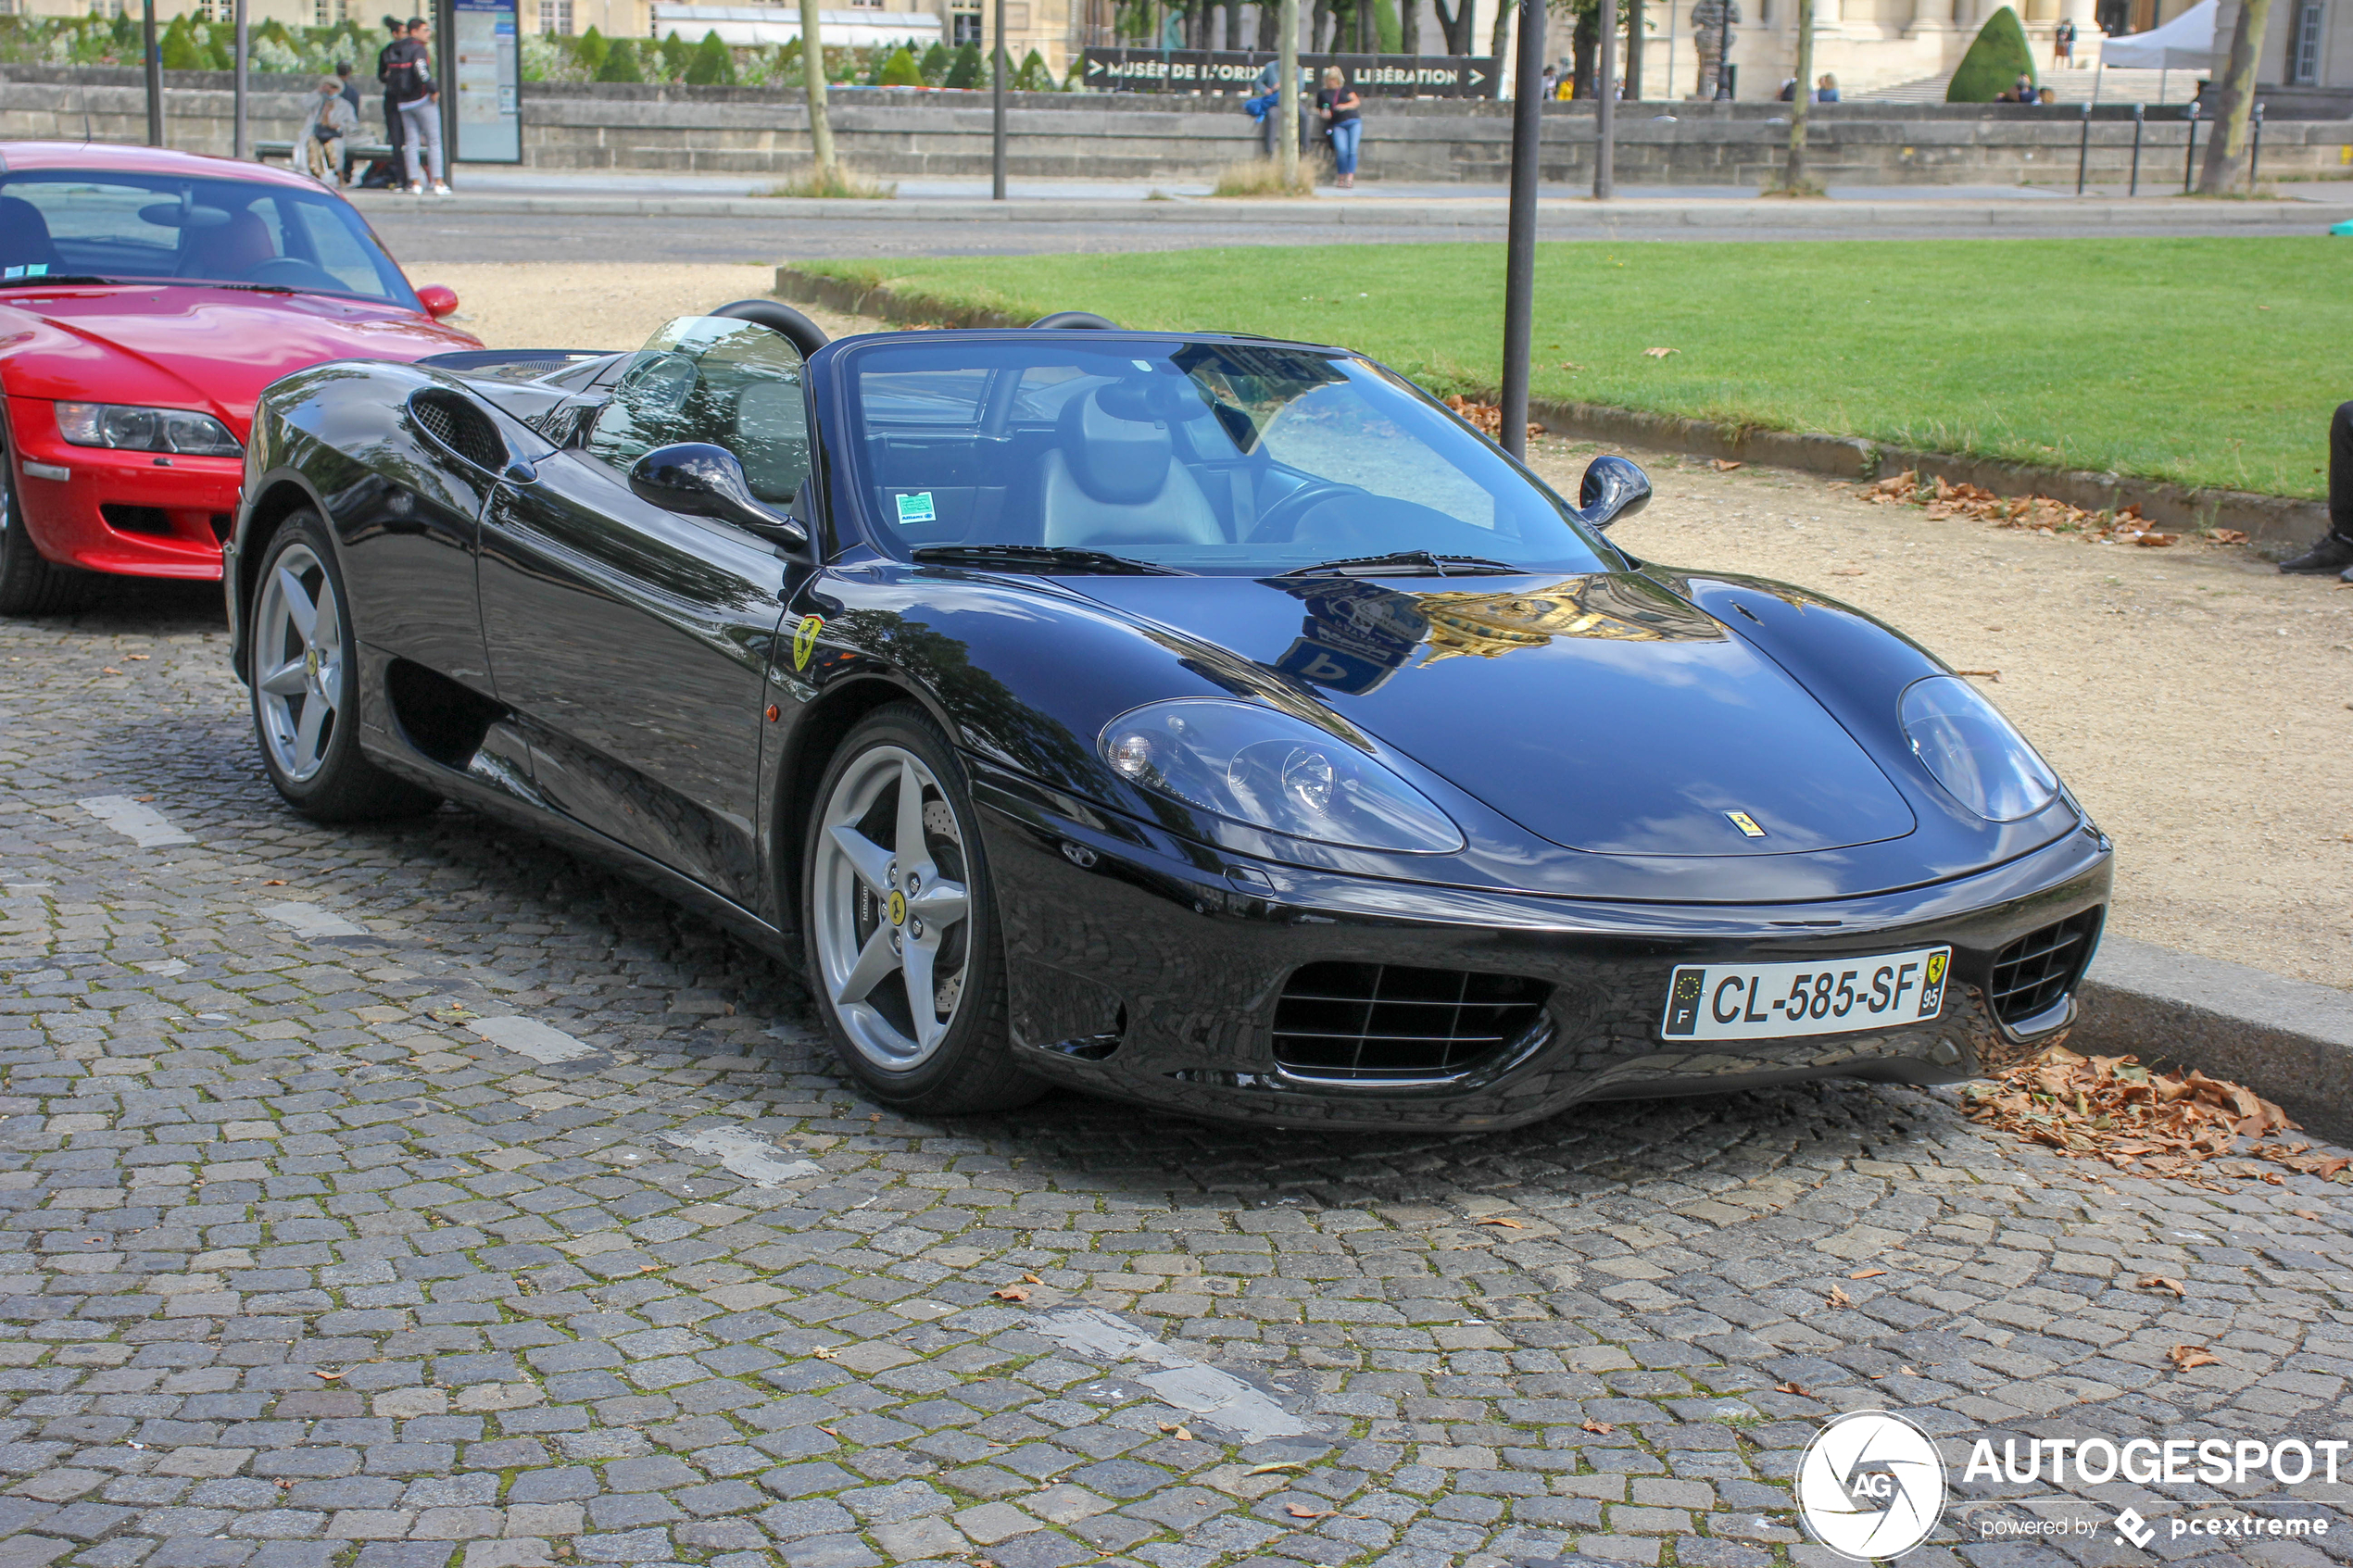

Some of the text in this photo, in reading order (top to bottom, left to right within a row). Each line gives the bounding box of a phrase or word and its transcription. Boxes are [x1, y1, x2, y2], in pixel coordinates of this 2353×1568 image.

[1107, 59, 1169, 79] MUSÉE
[1171, 63, 1196, 80] DE
[1201, 64, 1266, 82] L'ORD
[1353, 66, 1459, 84] LIBÉRATION
[1712, 963, 1919, 1023] CL-585-SF
[1922, 987, 1940, 1009] 95
[1677, 1010, 1690, 1023] F
